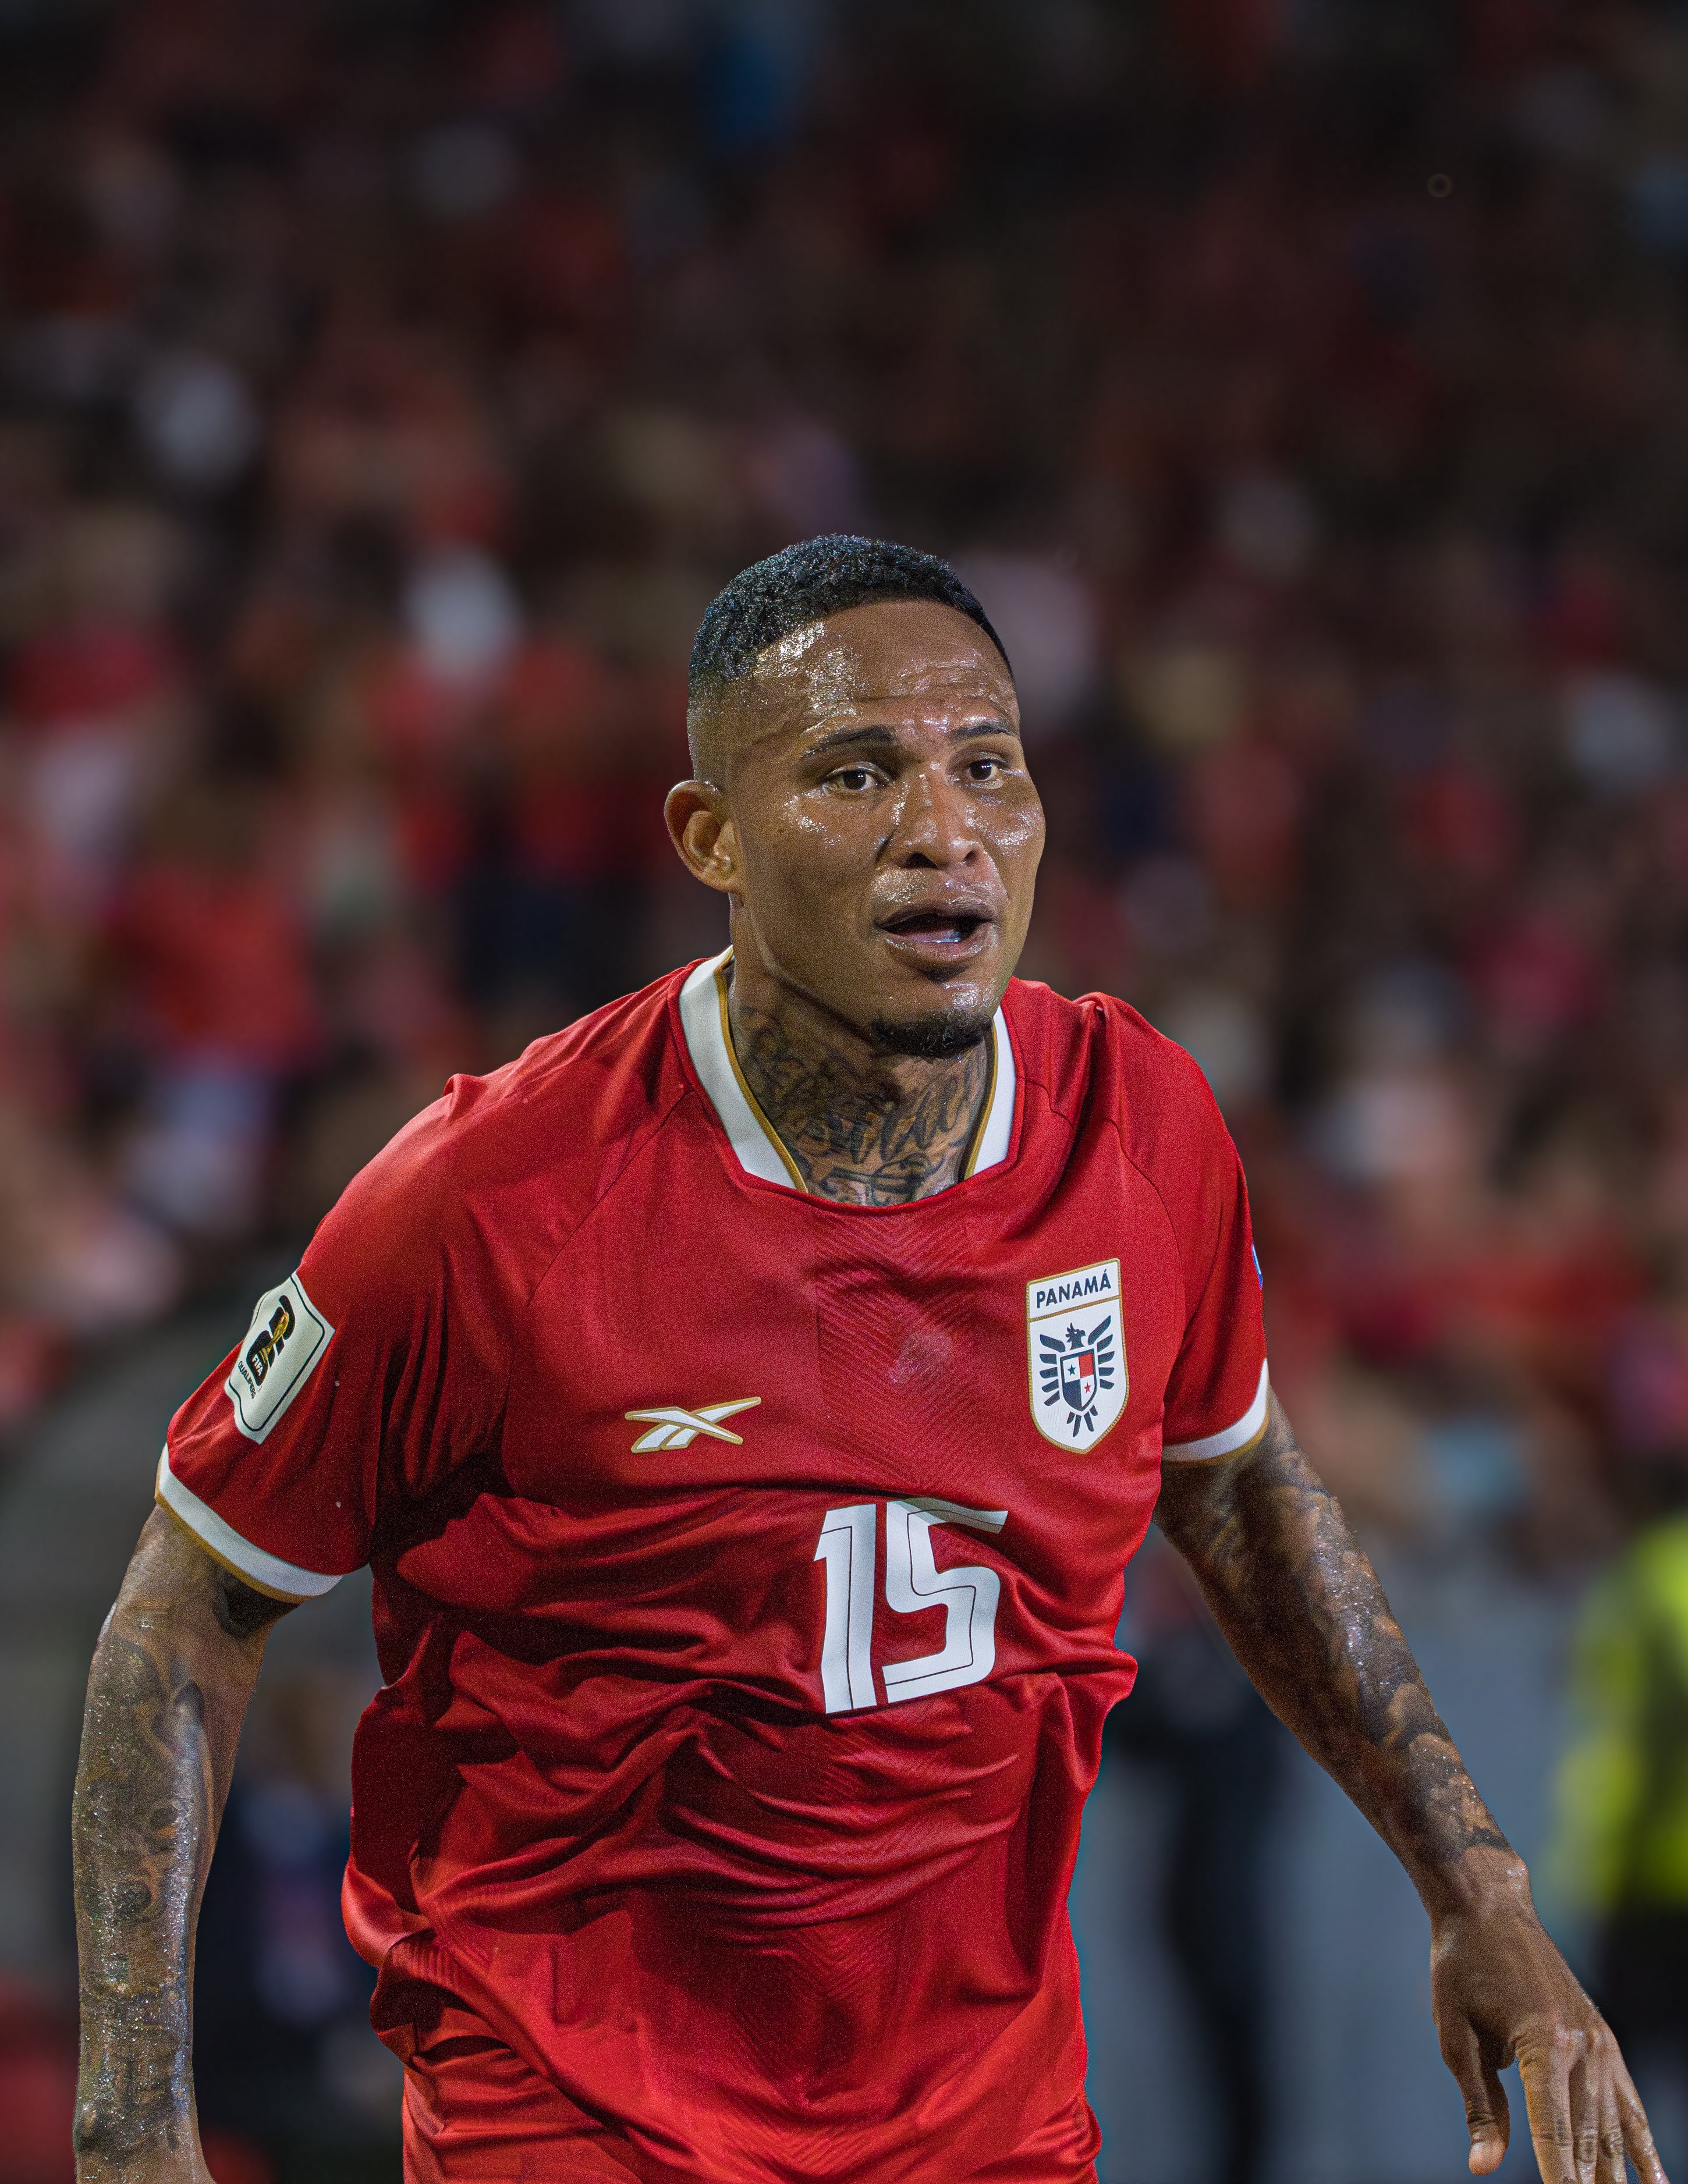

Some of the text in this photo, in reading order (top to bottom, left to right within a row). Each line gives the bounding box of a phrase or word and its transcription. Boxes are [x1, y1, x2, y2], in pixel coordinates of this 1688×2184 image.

[1037, 1269, 1111, 1308] PANAMÁ
[252, 1354, 264, 1376] FIFA
[814, 1497, 1008, 1714] 15
